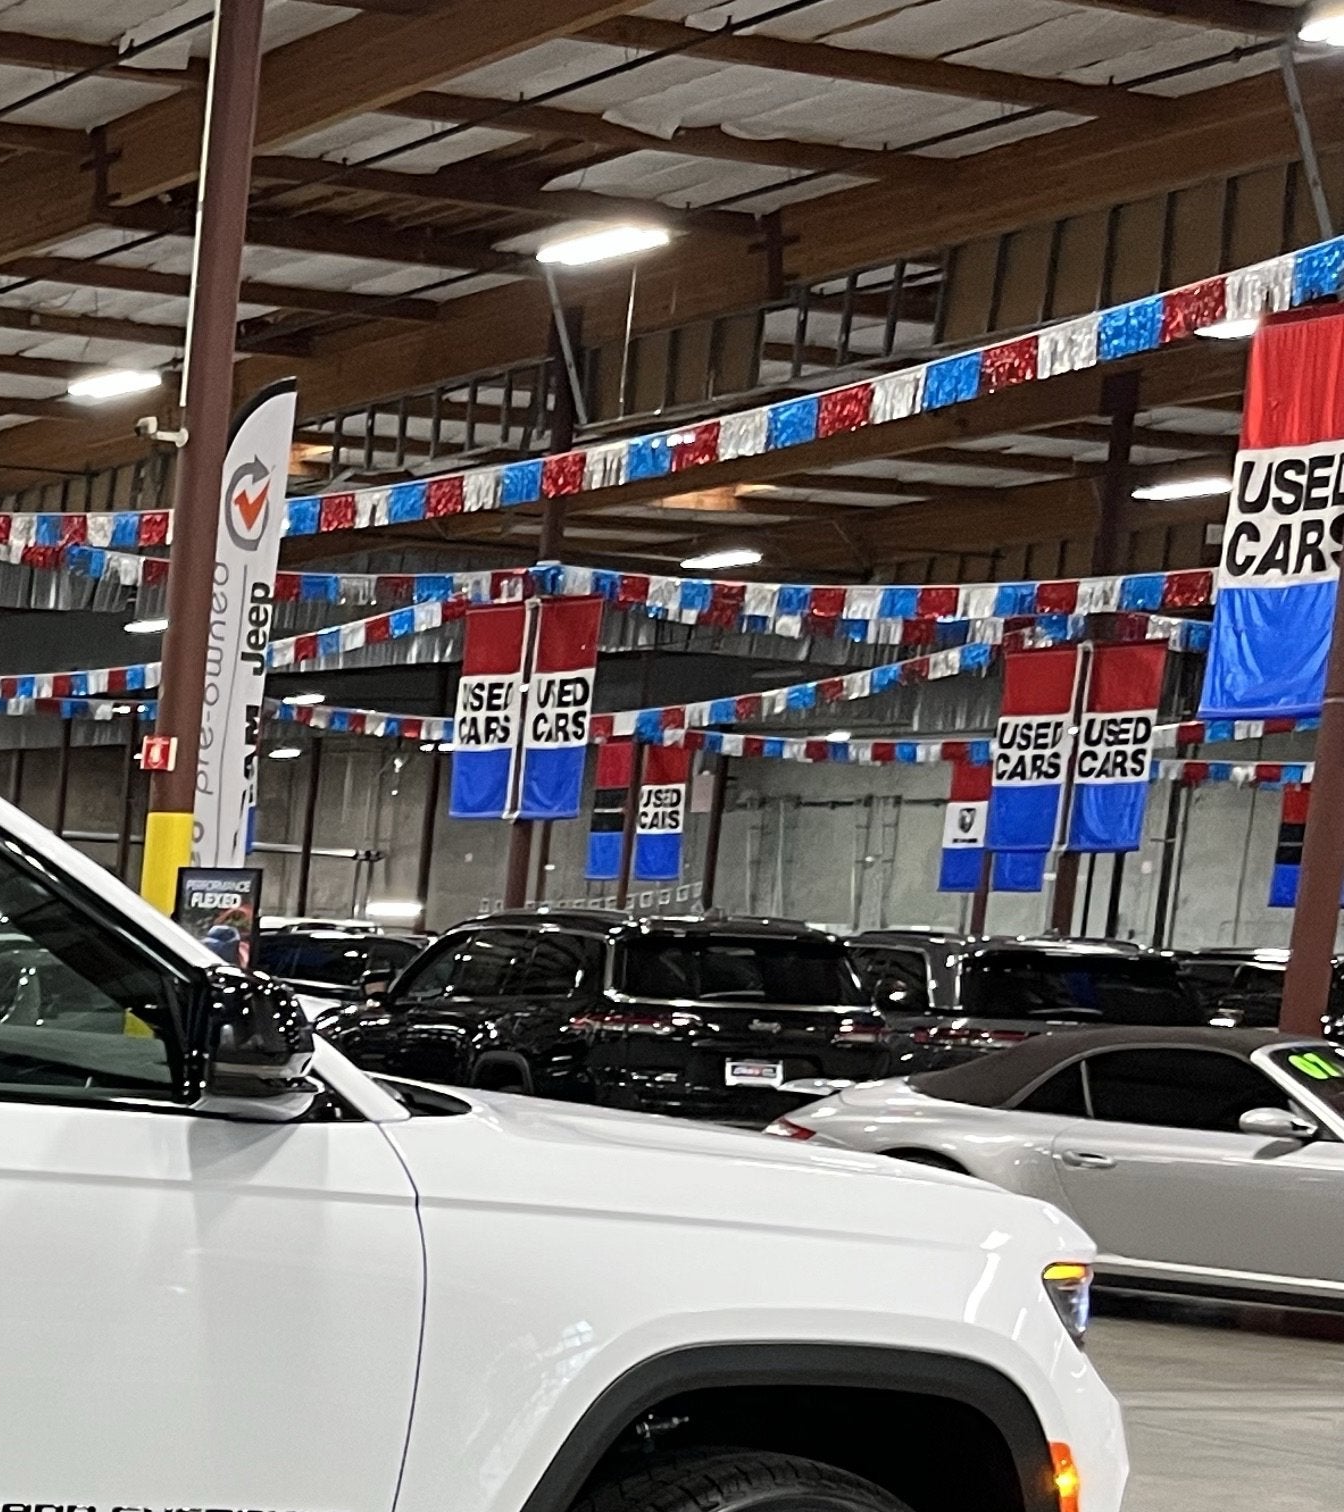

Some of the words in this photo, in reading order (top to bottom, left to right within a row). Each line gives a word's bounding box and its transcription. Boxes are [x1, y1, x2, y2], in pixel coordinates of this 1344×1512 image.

[241, 581, 272, 677] Jeep
[537, 676, 590, 709] UED
[998, 722, 1064, 751] USED
[1084, 716, 1152, 747] USED
[996, 751, 1062, 781] CARS
[1077, 748, 1147, 779] CARS
